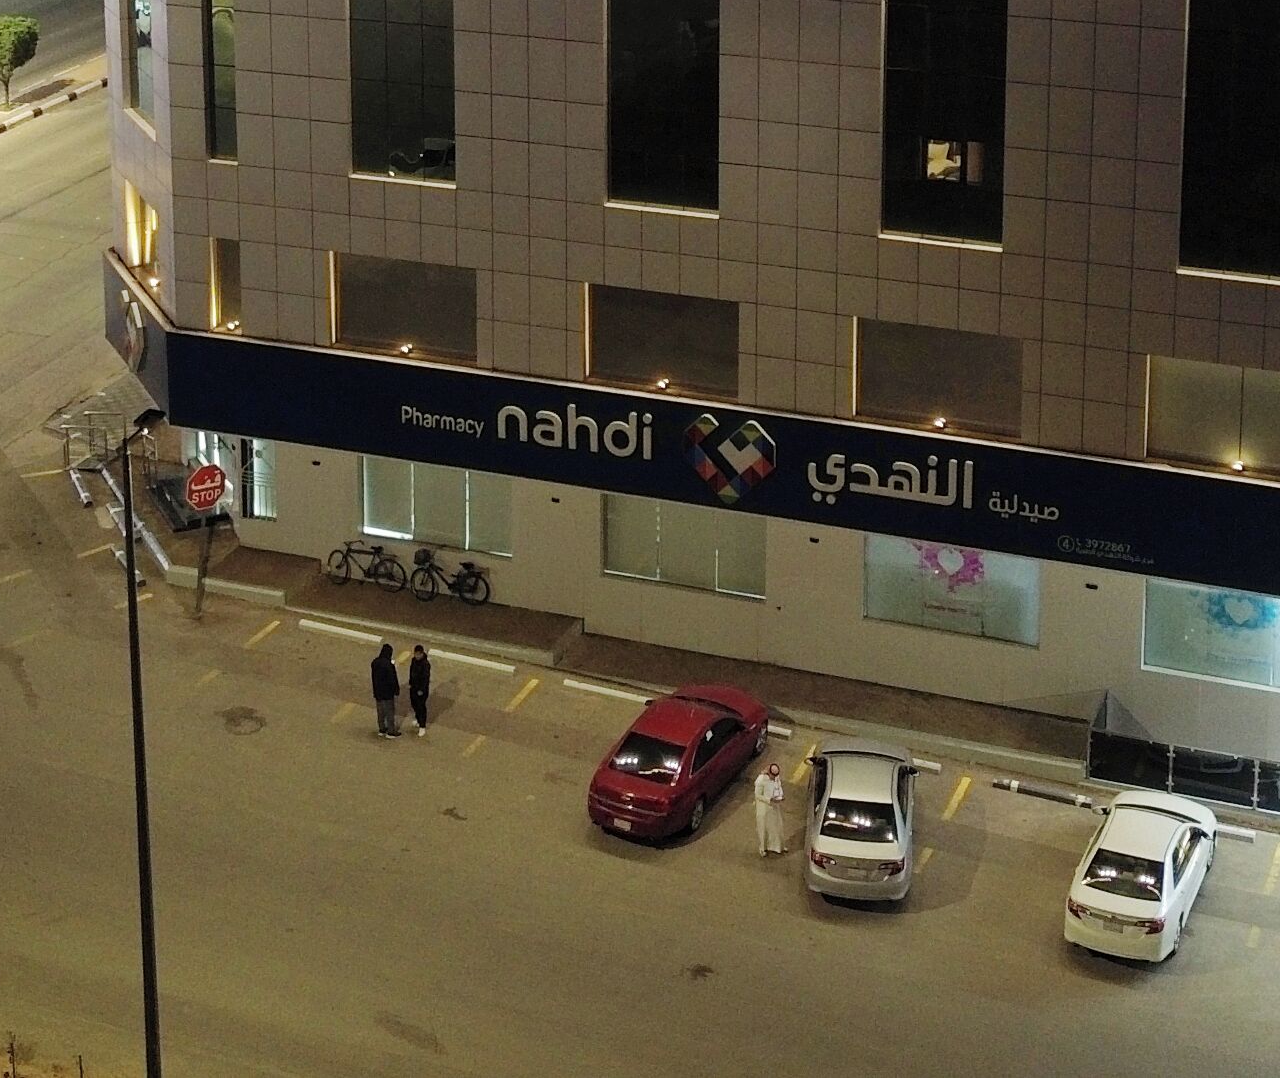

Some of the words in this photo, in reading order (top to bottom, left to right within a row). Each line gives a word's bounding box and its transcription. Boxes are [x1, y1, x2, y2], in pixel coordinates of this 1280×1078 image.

[401, 406, 484, 438] Pharmacy
[497, 403, 652, 460] nahdi
[191, 470, 222, 490] قف
[807, 453, 974, 509] النهدي
[192, 489, 221, 503] STOP
[988, 491, 1060, 522] صيدلية
